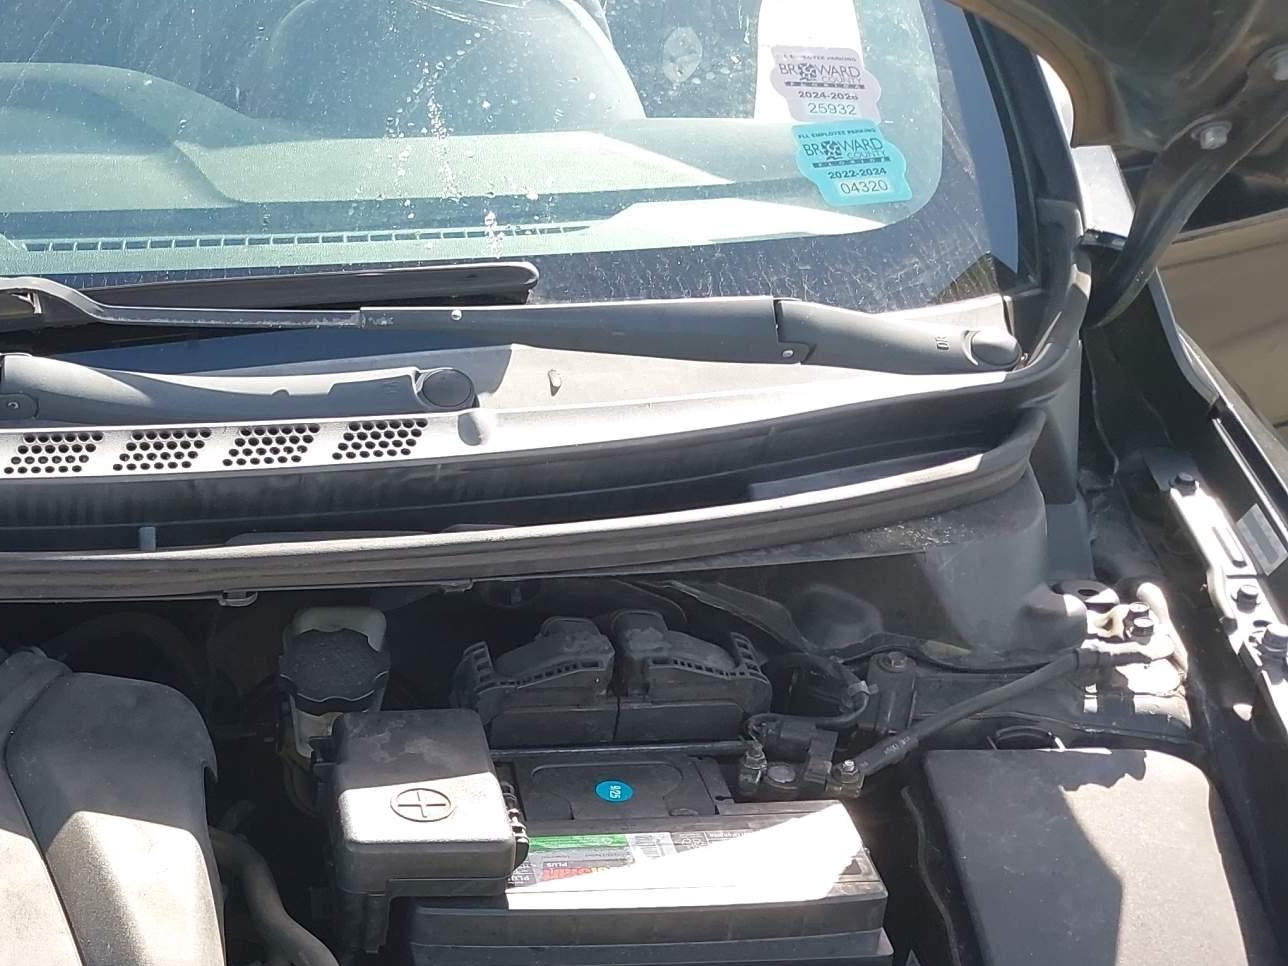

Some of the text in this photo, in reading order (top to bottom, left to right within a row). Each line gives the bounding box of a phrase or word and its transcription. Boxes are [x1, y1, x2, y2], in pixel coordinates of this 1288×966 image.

[779, 63, 861, 79] BROWARD
[822, 76, 861, 84] COUNTY
[808, 103, 856, 115] 25932
[802, 137, 884, 158] BROWARD
[846, 150, 886, 159] COUNTY
[828, 168, 887, 179] 2022-2024
[840, 180, 889, 194] 04320
